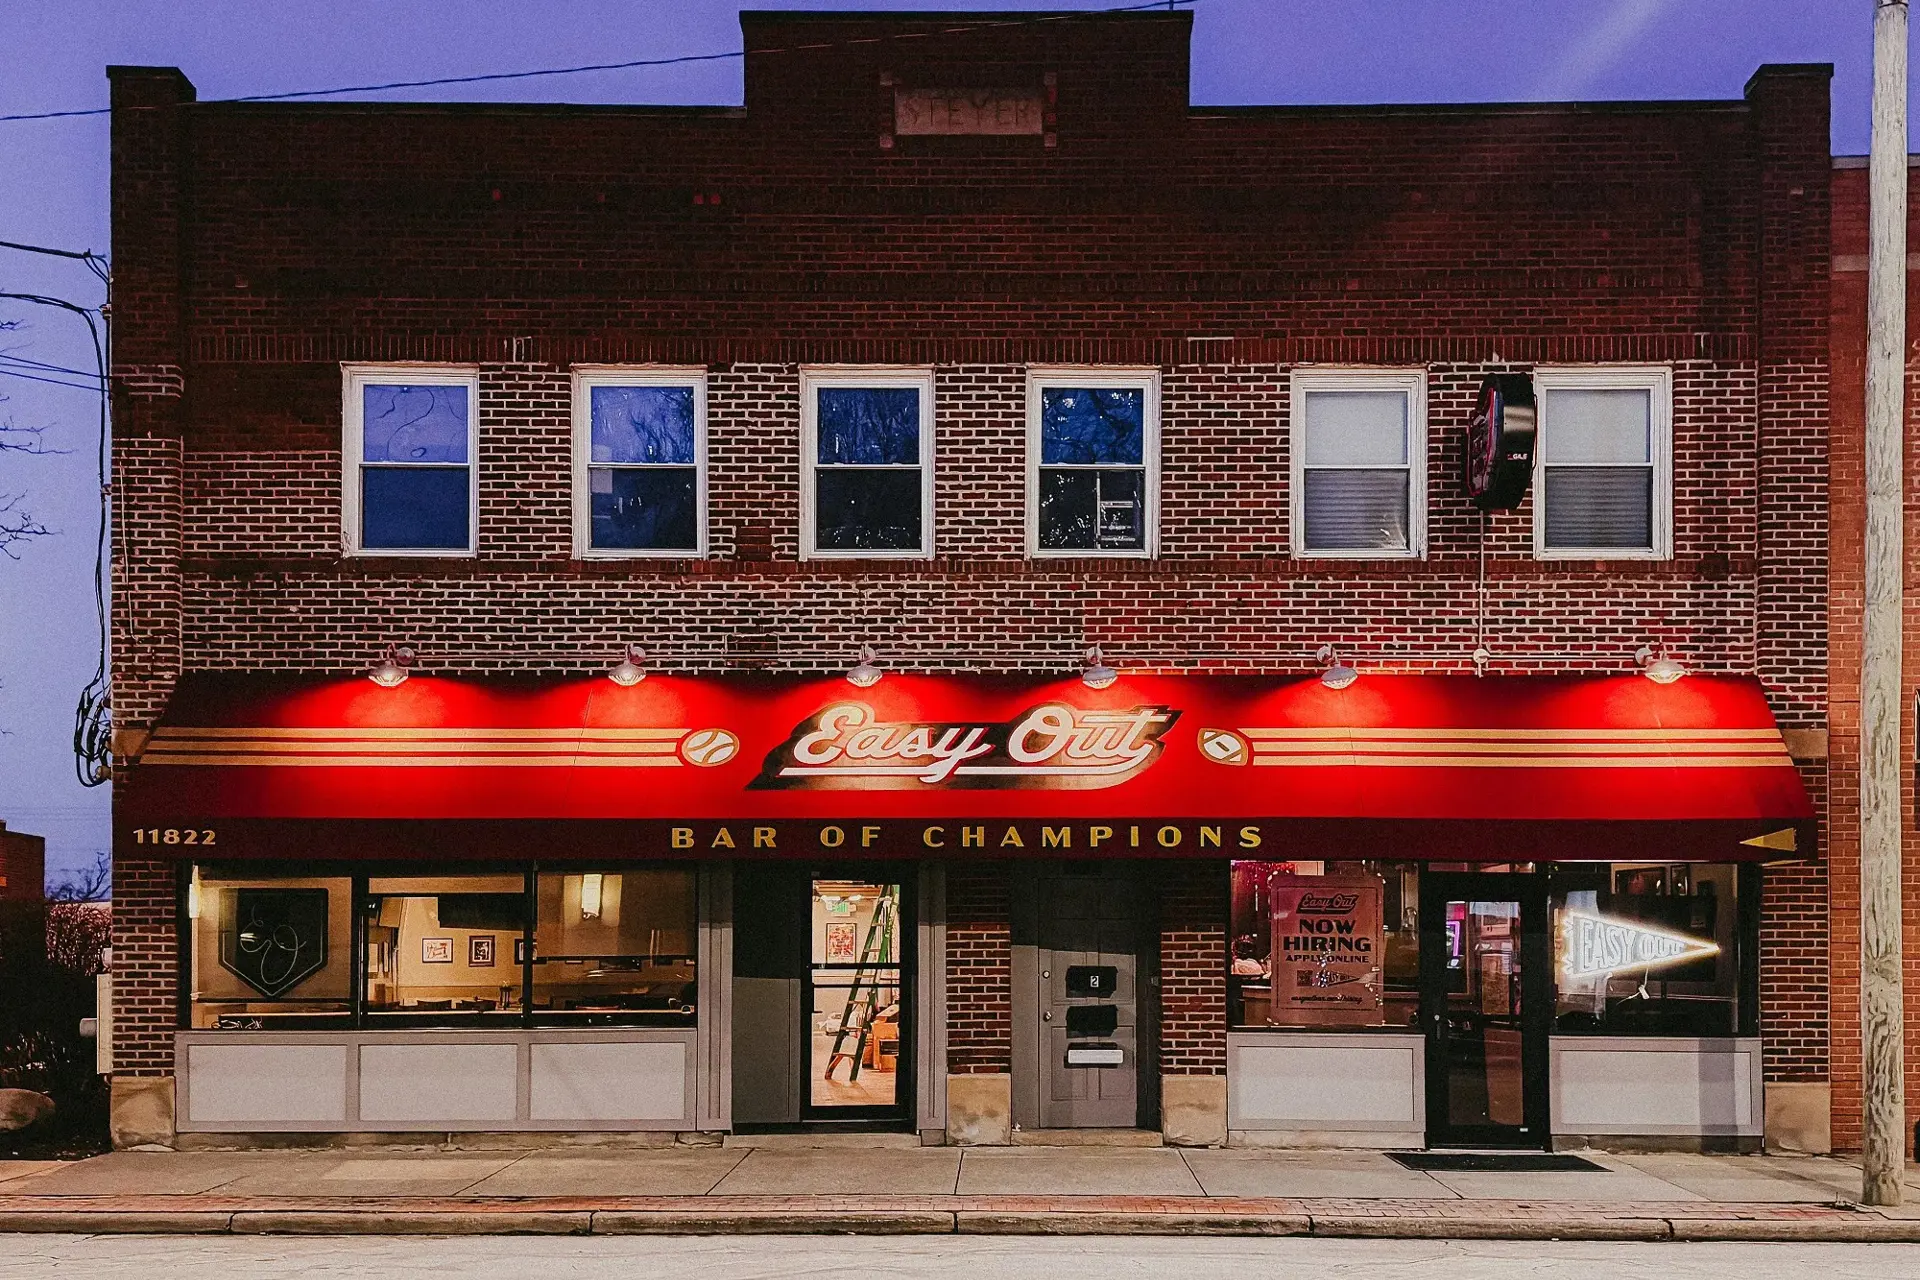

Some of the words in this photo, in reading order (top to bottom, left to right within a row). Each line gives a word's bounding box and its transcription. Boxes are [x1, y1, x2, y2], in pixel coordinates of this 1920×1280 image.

[786, 703, 994, 784] Easy
[1006, 704, 1169, 774] Out
[132, 828, 216, 845] 11822
[671, 827, 777, 848] BAR
[820, 826, 881, 847] OF
[923, 826, 1262, 848] CHAMPIONS
[1302, 894, 1331, 911] Easy
[1332, 894, 1357, 909] Out
[1299, 919, 1356, 934] NOW
[1283, 936, 1372, 952] HIRING
[1579, 918, 1637, 972] EASY
[1638, 933, 1686, 962] OUT
[1285, 955, 1325, 963] APPLY
[1326, 955, 1369, 963] ONLINE
[1091, 976, 1098, 986] 2
